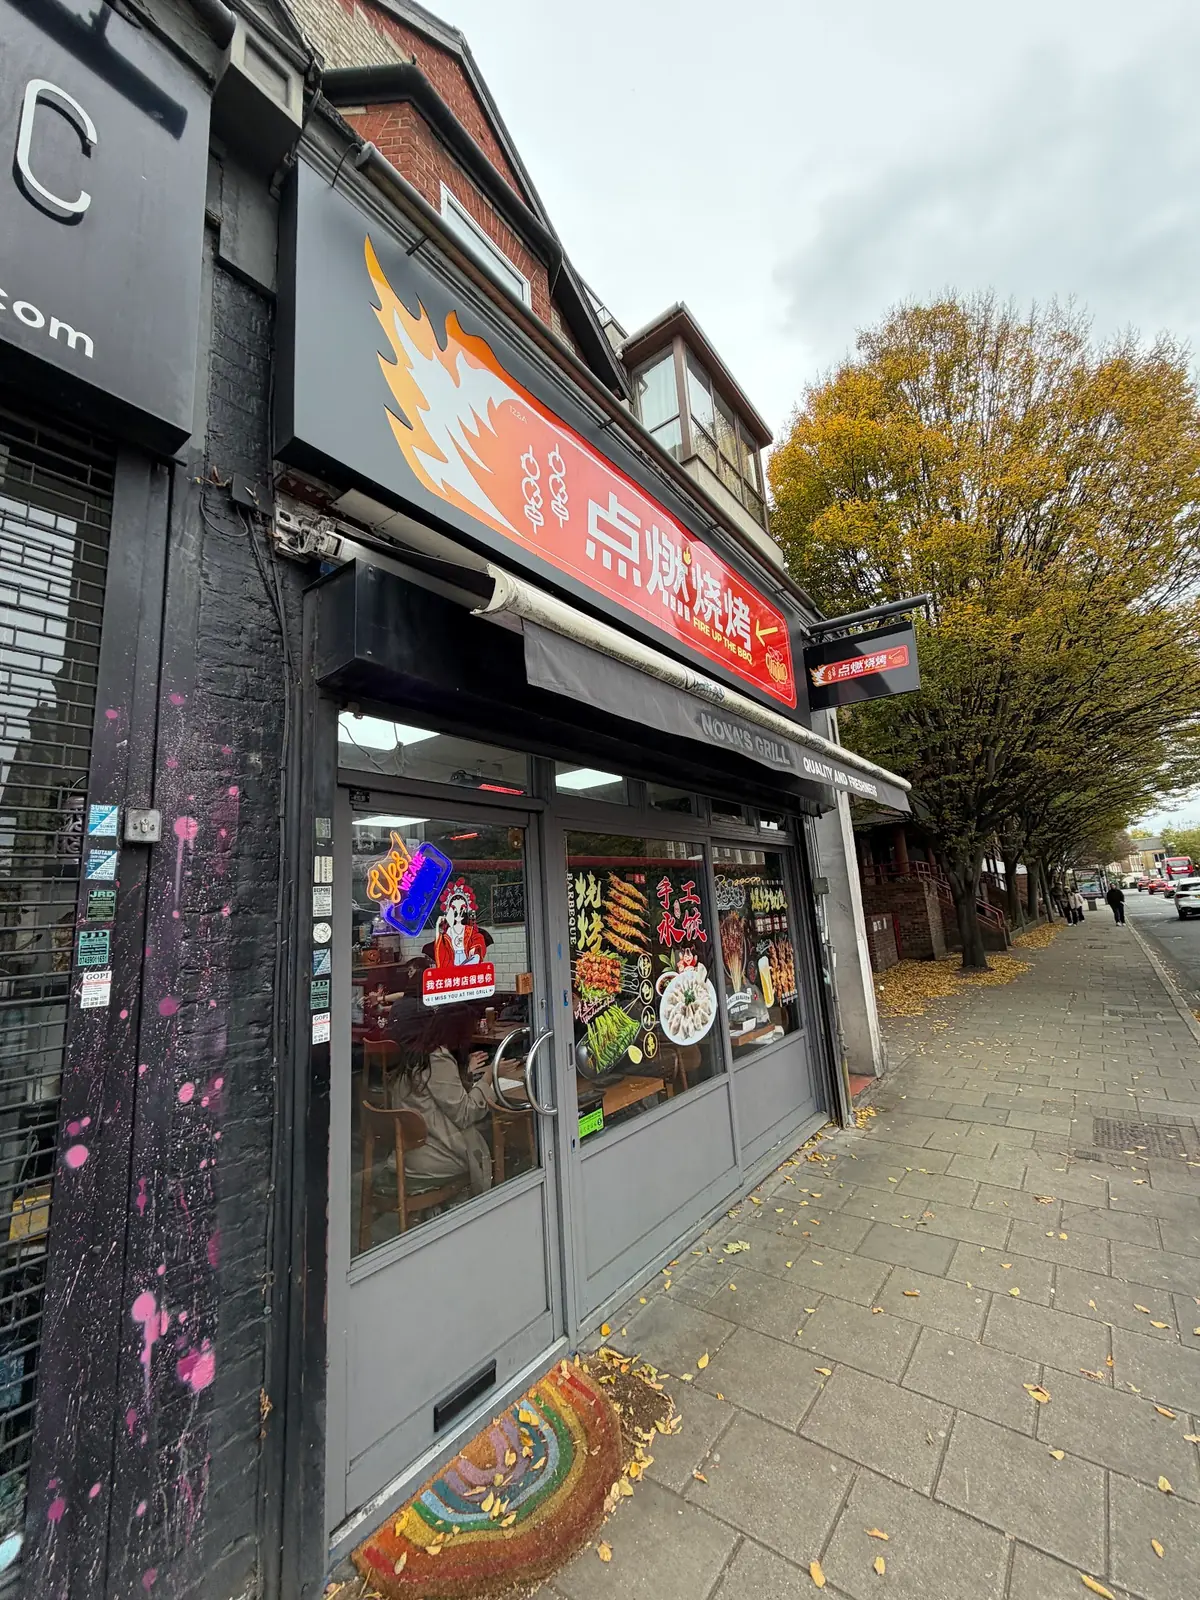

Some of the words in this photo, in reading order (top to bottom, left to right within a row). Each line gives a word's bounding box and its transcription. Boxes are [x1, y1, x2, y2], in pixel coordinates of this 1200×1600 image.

[0, 288, 94, 359] om
[585, 491, 752, 652] 点燃烧烤
[693, 616, 711, 637] FIRE
[711, 629, 723, 643] UP
[723, 637, 737, 654] THE
[737, 646, 753, 665] BBQ
[838, 654, 887, 677] 点燃烧烤
[755, 735, 791, 765] GRILL
[803, 756, 833, 781] QUALITY
[834, 769, 848, 786] AND
[848, 775, 878, 797] FRESHNESS
[397, 869, 416, 891] WE
[408, 850, 427, 877] ARE
[567, 873, 577, 945] BARBEQUE
[575, 870, 605, 952] 烧烤
[86, 972, 109, 980] GOPI
